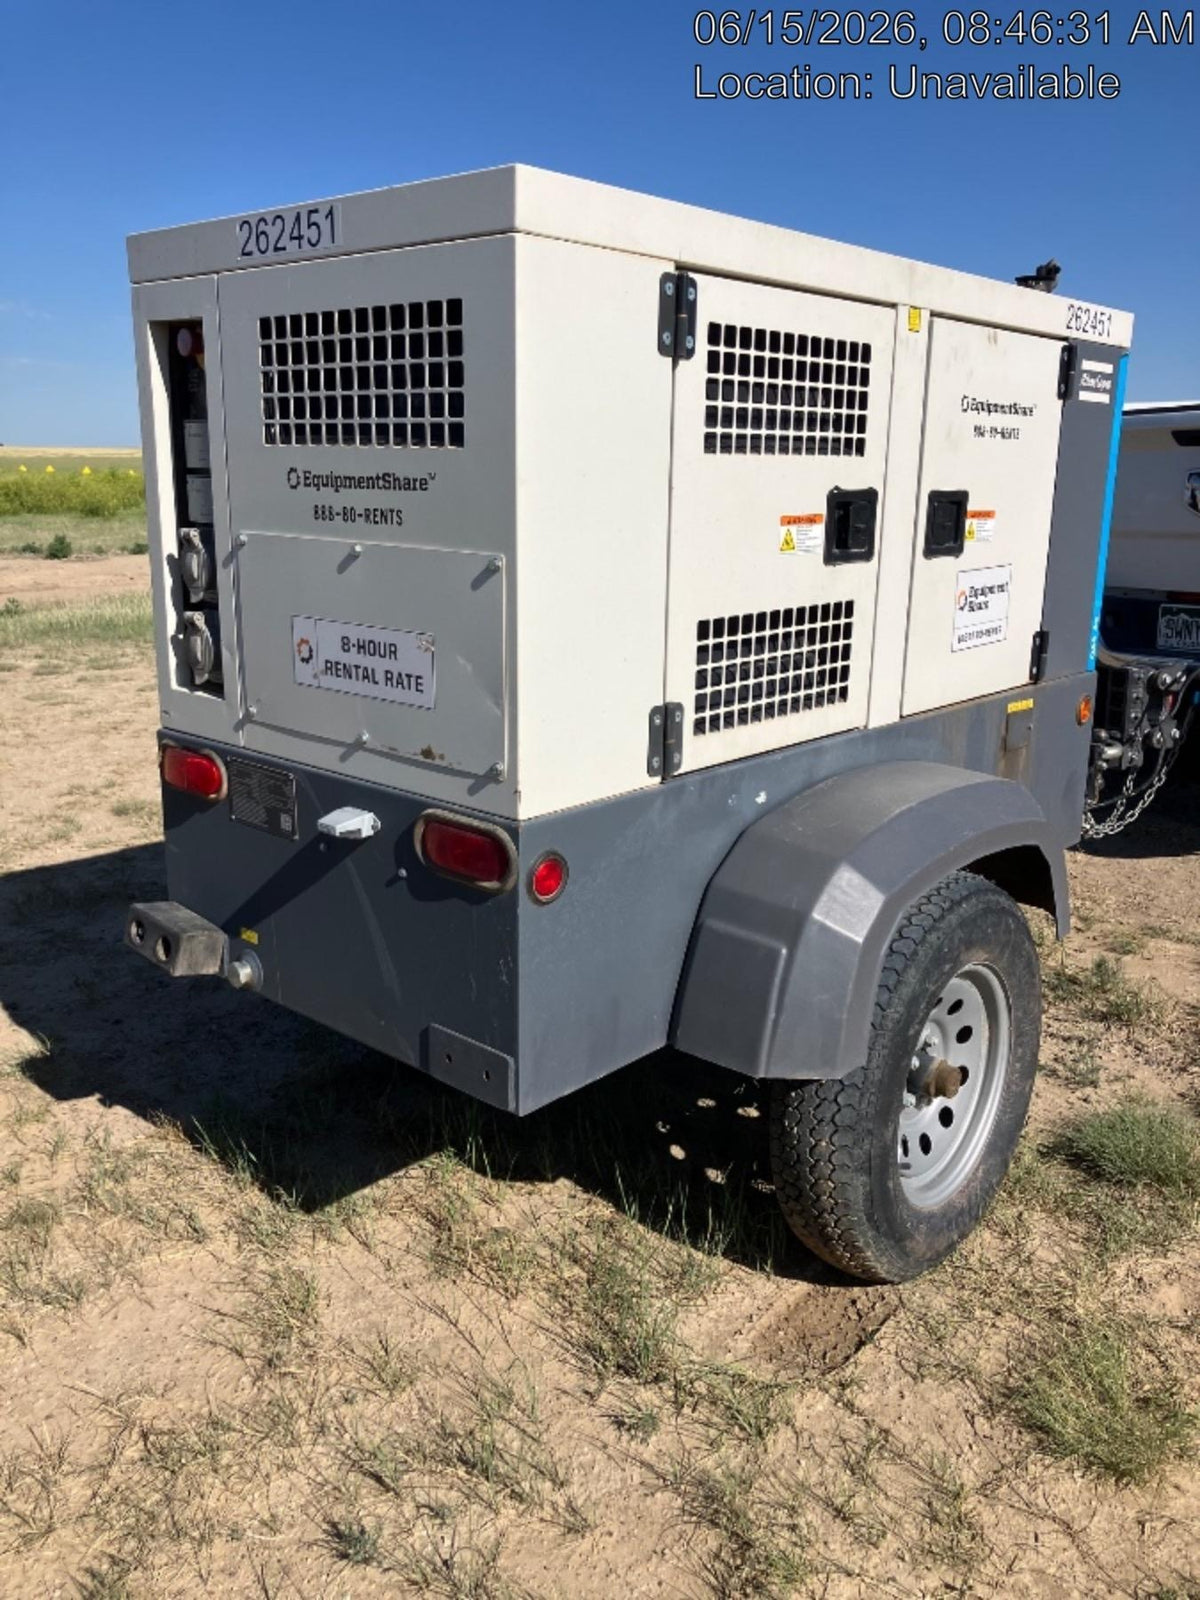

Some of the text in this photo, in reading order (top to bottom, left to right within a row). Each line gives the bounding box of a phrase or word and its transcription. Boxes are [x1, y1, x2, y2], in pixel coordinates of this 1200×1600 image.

[239, 205, 335, 257] 262451
[1065, 303, 1113, 338] 262451
[313, 503, 404, 527] 888-80-RENTS
[340, 635, 399, 661] 8-HOUR
[324, 659, 425, 694] RENTAL RATE
